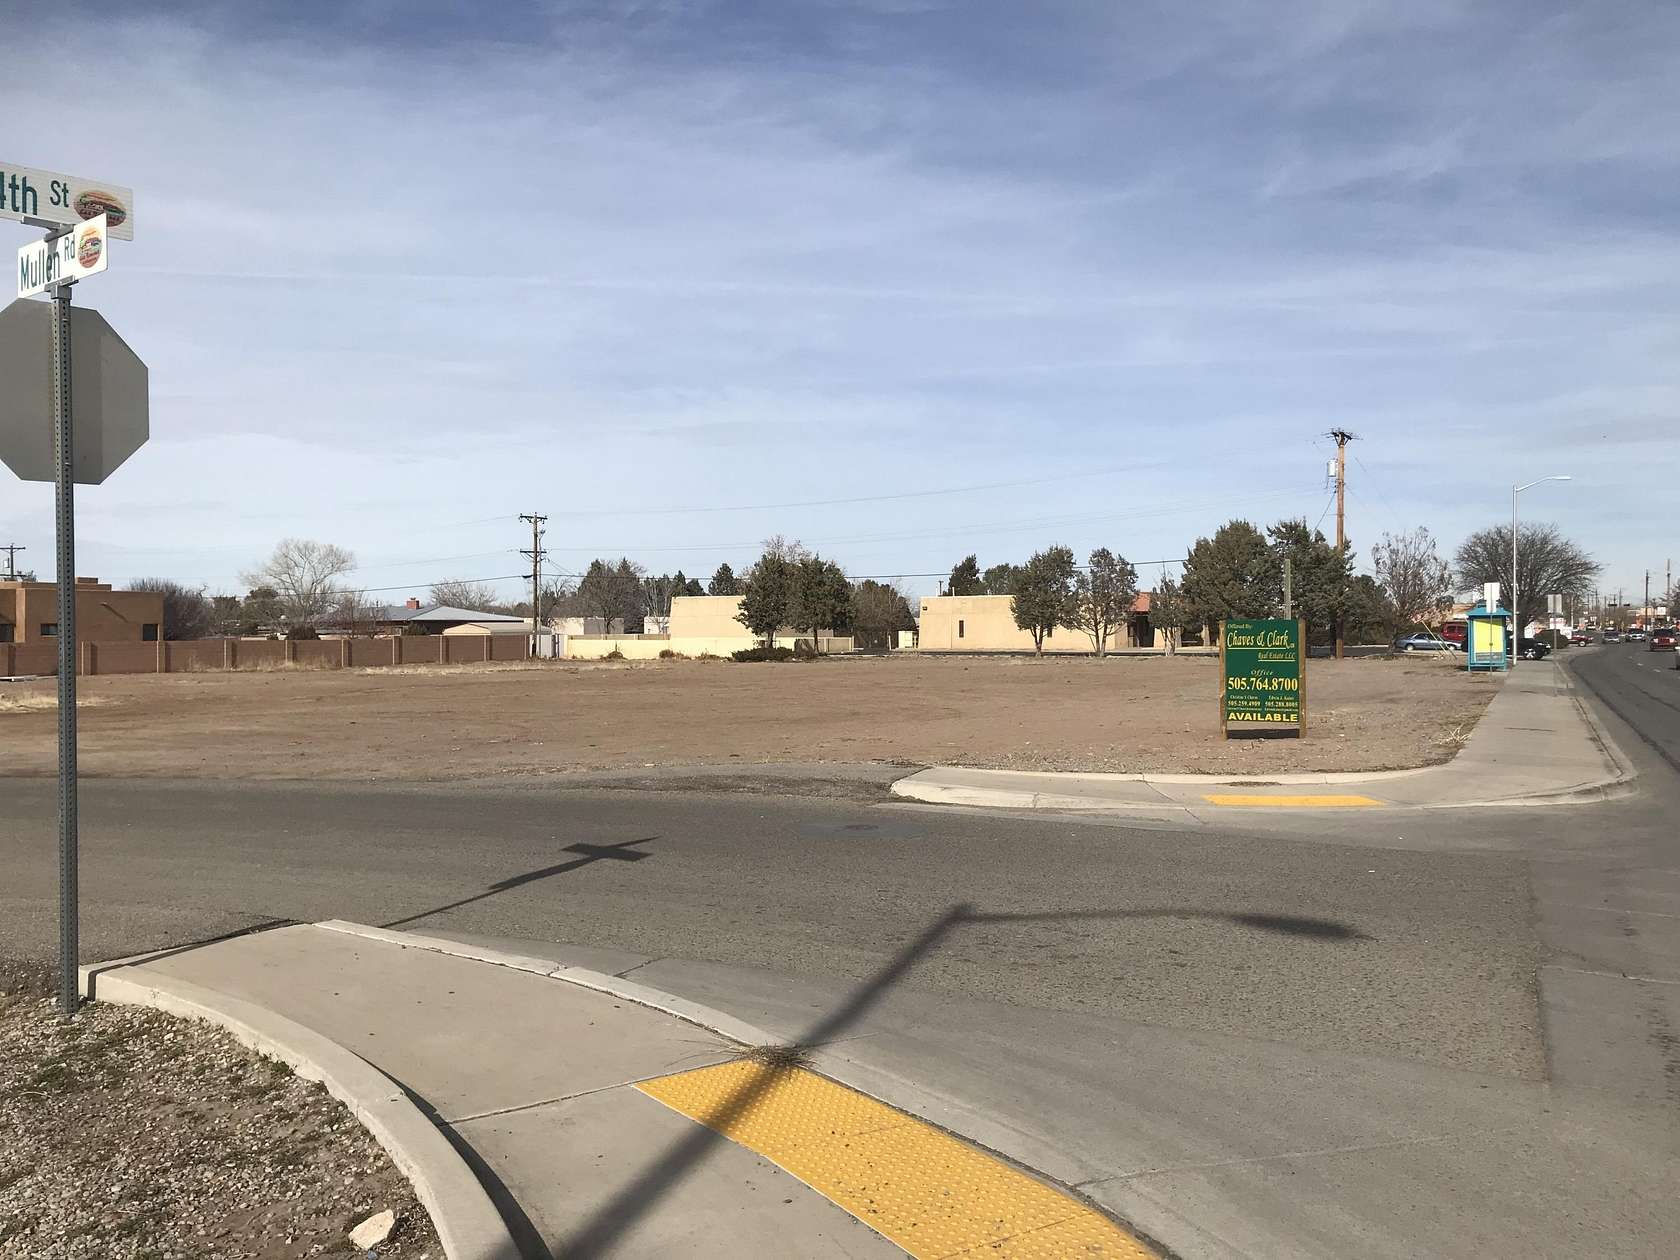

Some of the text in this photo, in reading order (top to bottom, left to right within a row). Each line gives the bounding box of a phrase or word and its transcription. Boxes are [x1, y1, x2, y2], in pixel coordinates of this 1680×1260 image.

[49, 180, 69, 208] St
[20, 247, 61, 291] Mullen
[64, 234, 76, 262] Rd
[1227, 630, 1290, 649] Chaves & Clark
[1250, 669, 1273, 677] Office
[1228, 677, 1298, 691] 505.764.8700
[1228, 712, 1298, 722] AVAILABLE
